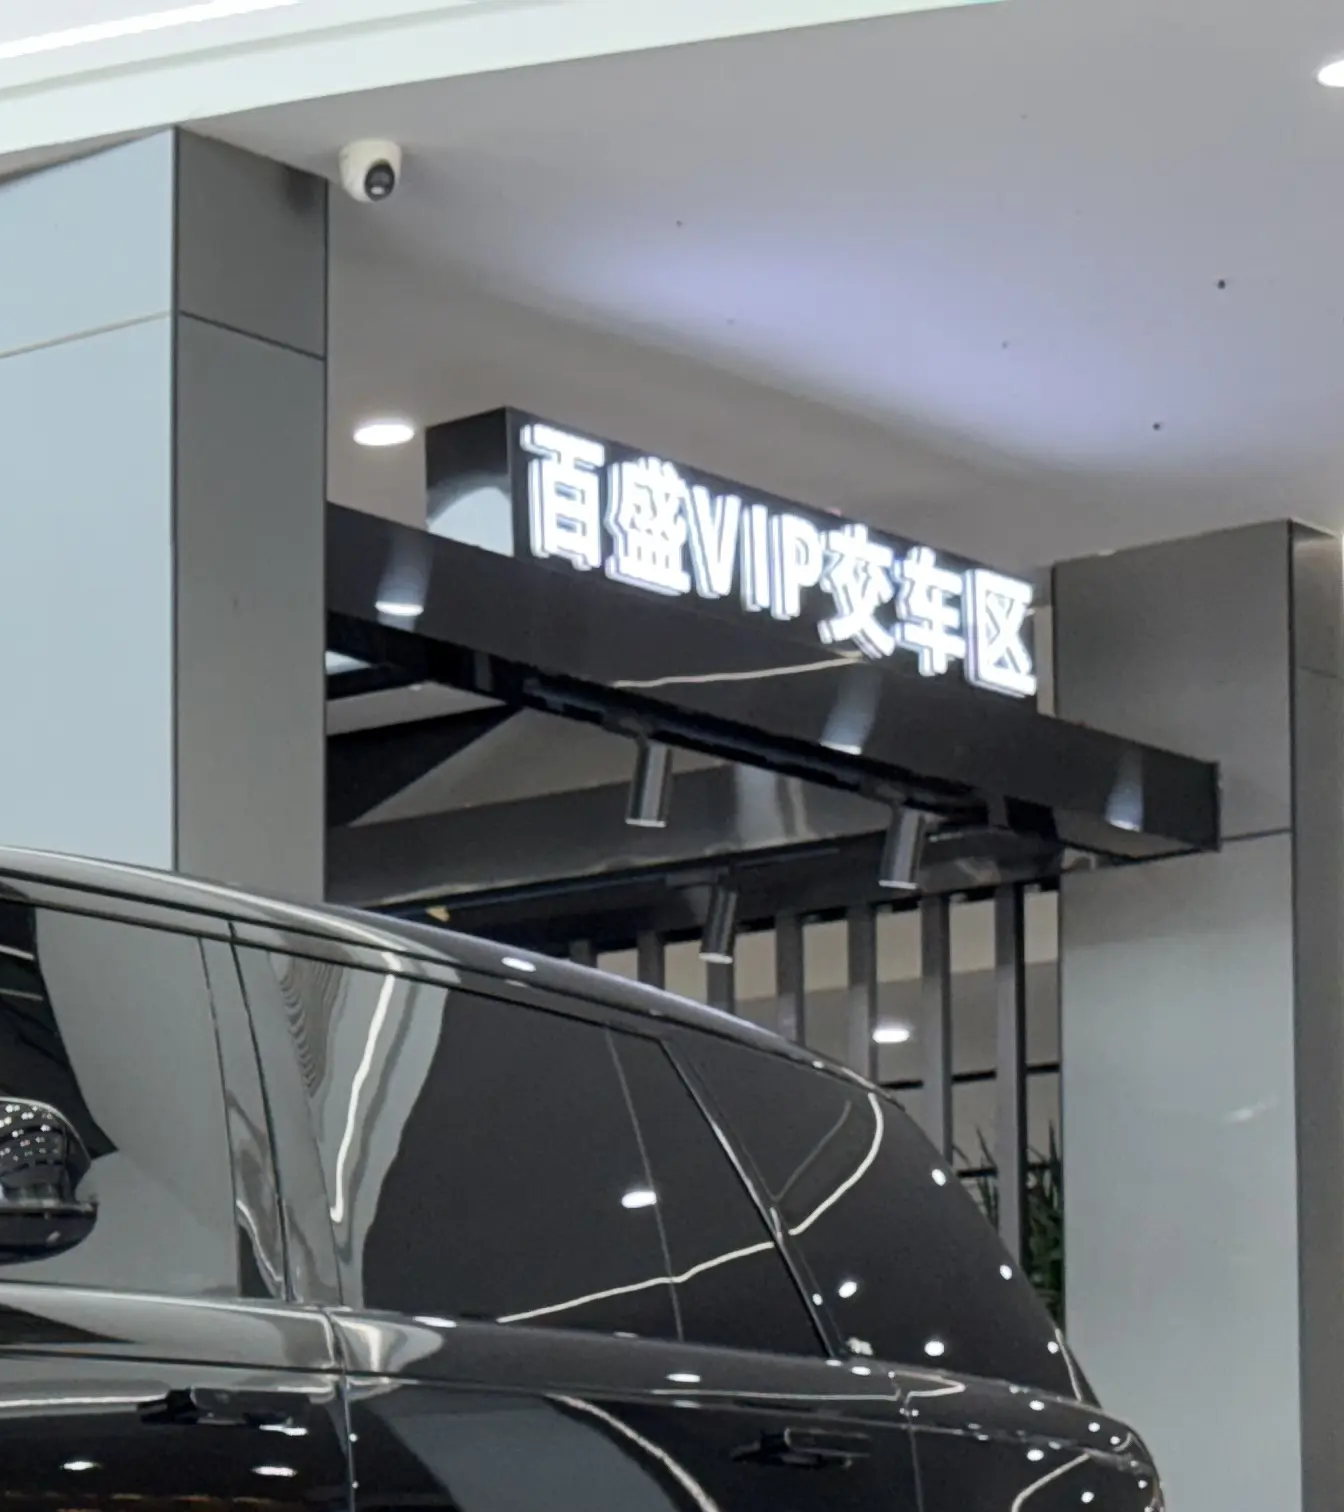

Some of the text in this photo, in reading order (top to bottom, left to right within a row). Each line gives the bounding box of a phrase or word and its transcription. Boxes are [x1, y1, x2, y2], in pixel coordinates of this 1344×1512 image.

[520, 424, 1036, 697] 百盛VIP交车区
